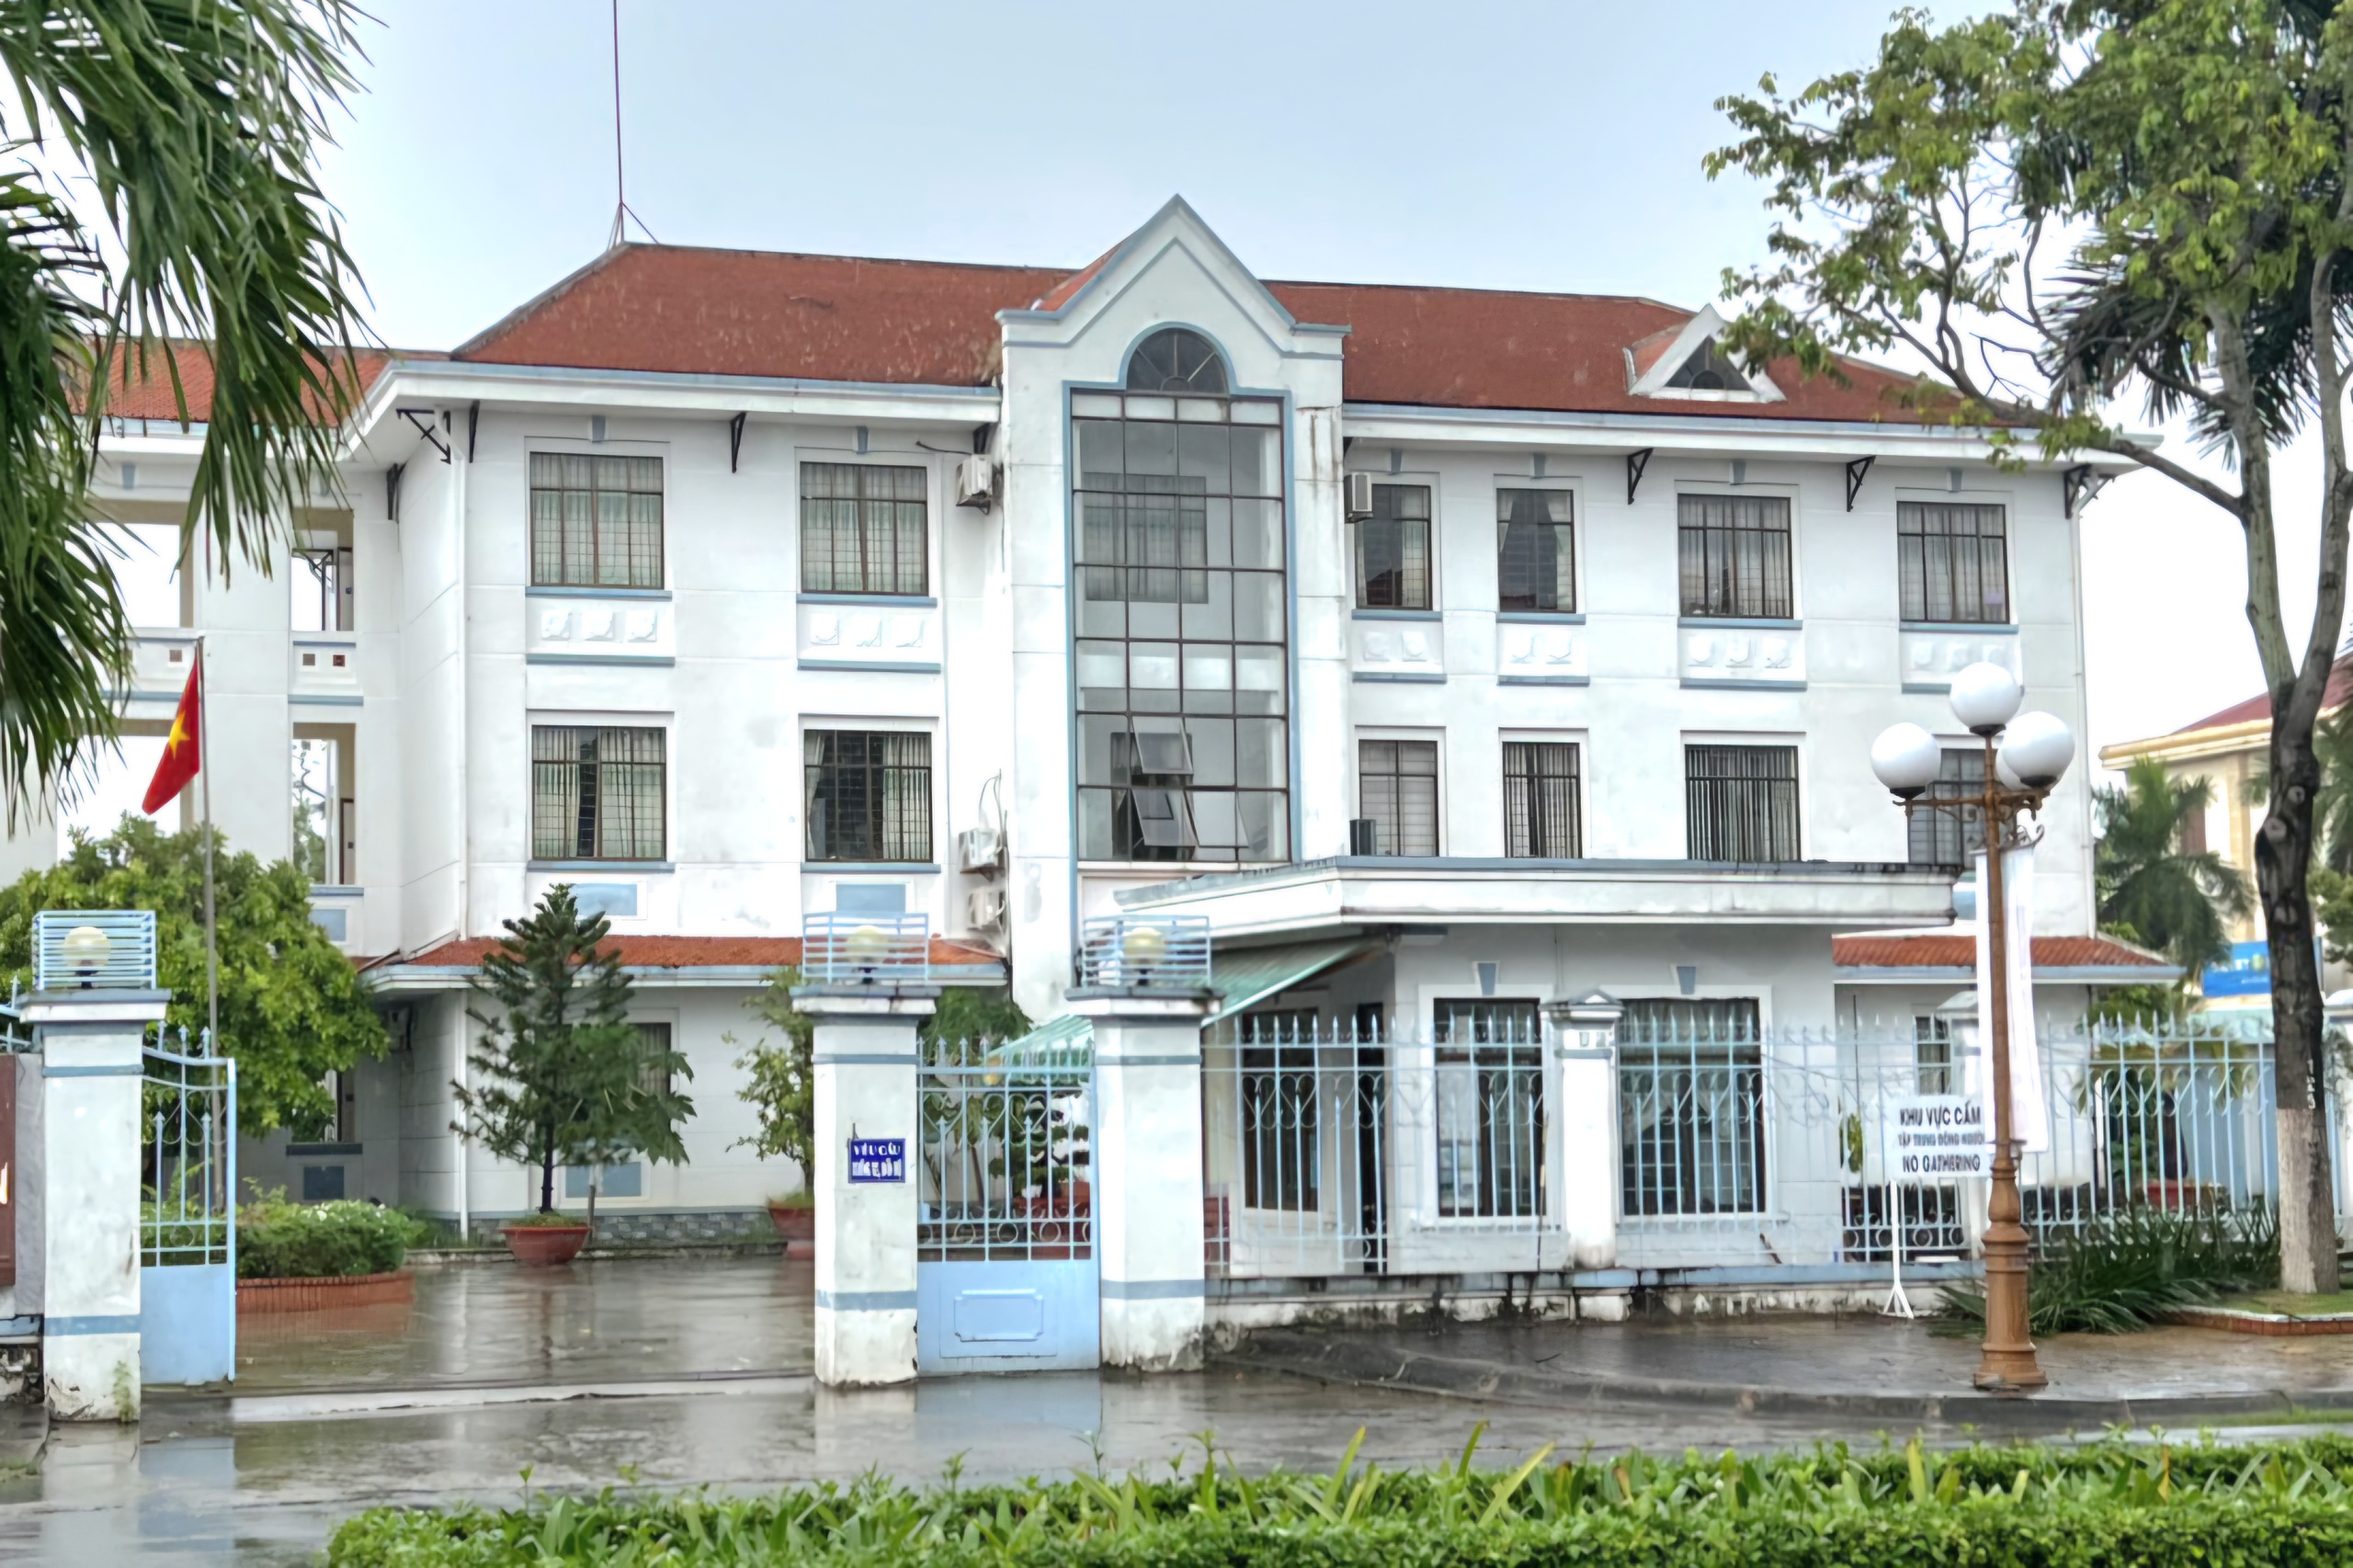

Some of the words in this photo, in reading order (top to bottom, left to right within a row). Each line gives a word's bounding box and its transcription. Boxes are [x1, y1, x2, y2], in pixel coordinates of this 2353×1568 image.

[1900, 1108, 1923, 1126] KHU
[1903, 1155, 1918, 1172] NO
[1923, 1154, 1981, 1172] GATHERING
